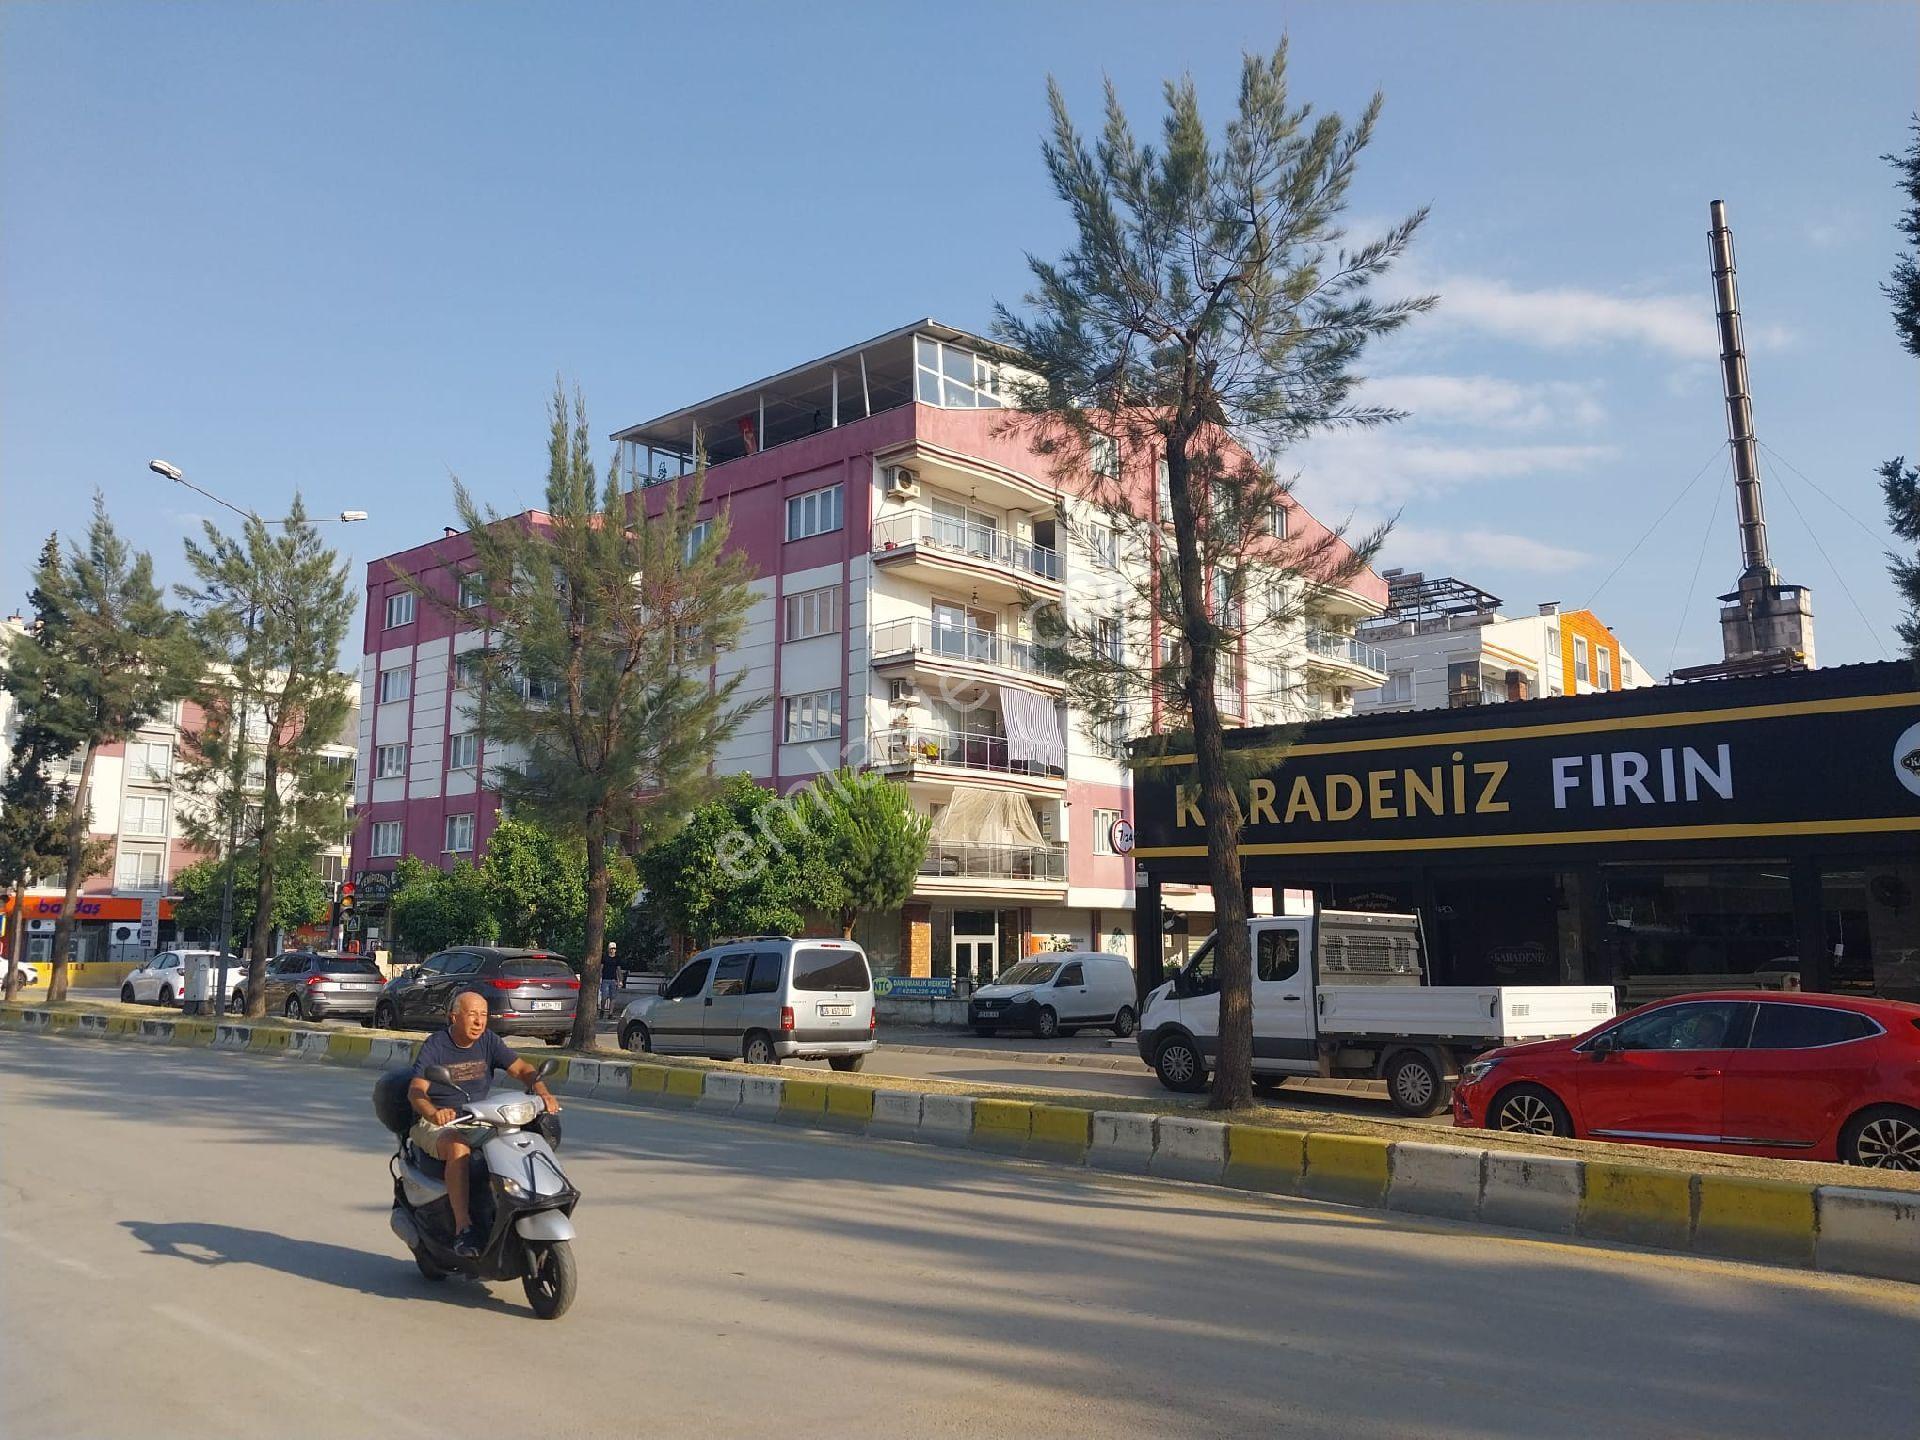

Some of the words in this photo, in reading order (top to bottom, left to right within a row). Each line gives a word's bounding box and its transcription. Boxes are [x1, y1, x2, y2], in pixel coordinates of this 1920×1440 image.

[1552, 743, 1734, 809] FIRIN
[39, 897, 102, 914] badas
[873, 981, 889, 991] NTC
